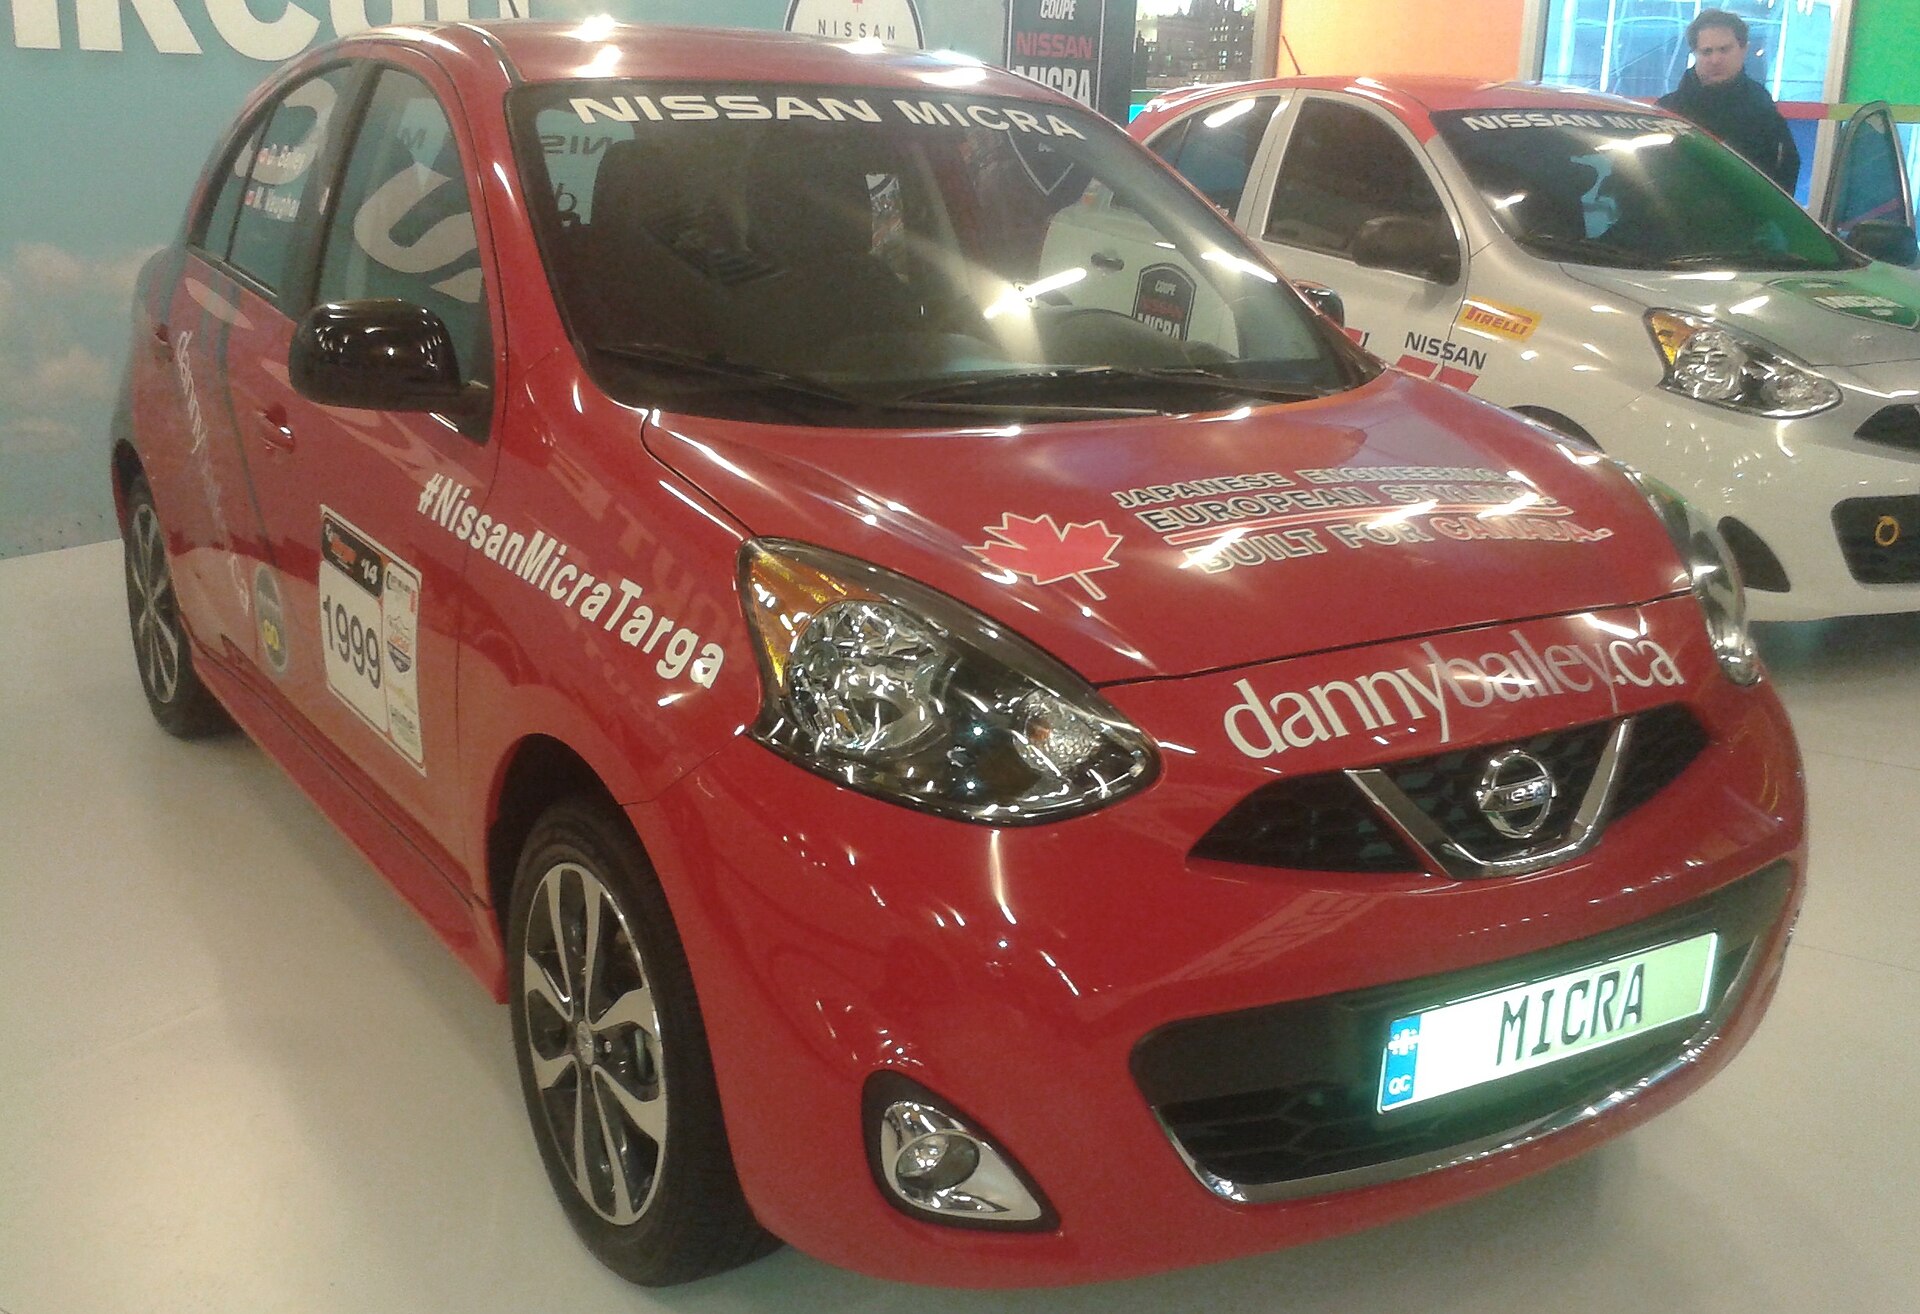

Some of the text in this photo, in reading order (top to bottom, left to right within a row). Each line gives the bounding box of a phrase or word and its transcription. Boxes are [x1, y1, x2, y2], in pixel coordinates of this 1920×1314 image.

[817, 19, 896, 40] NISSAN
[1040, 0, 1076, 20] COUPE
[1015, 32, 1093, 58] NISSAN
[1015, 66, 1091, 106] CRA
[570, 95, 1085, 141] NISSAN MICRA
[1462, 113, 1602, 132] NISSAN
[1465, 306, 1533, 336] PIRELLI
[1404, 331, 1488, 370] NISSAN
[1111, 472, 1297, 509] JAPANESE
[1134, 486, 1381, 533] EUROPEAN
[1183, 527, 1328, 574] BUILT
[1325, 519, 1435, 549] FOR
[417, 472, 725, 689] #NissanMicraTarga
[322, 594, 381, 690] 1999
[1223, 629, 1686, 759] dannybailey.ca
[1496, 962, 1646, 1066] MICRA
